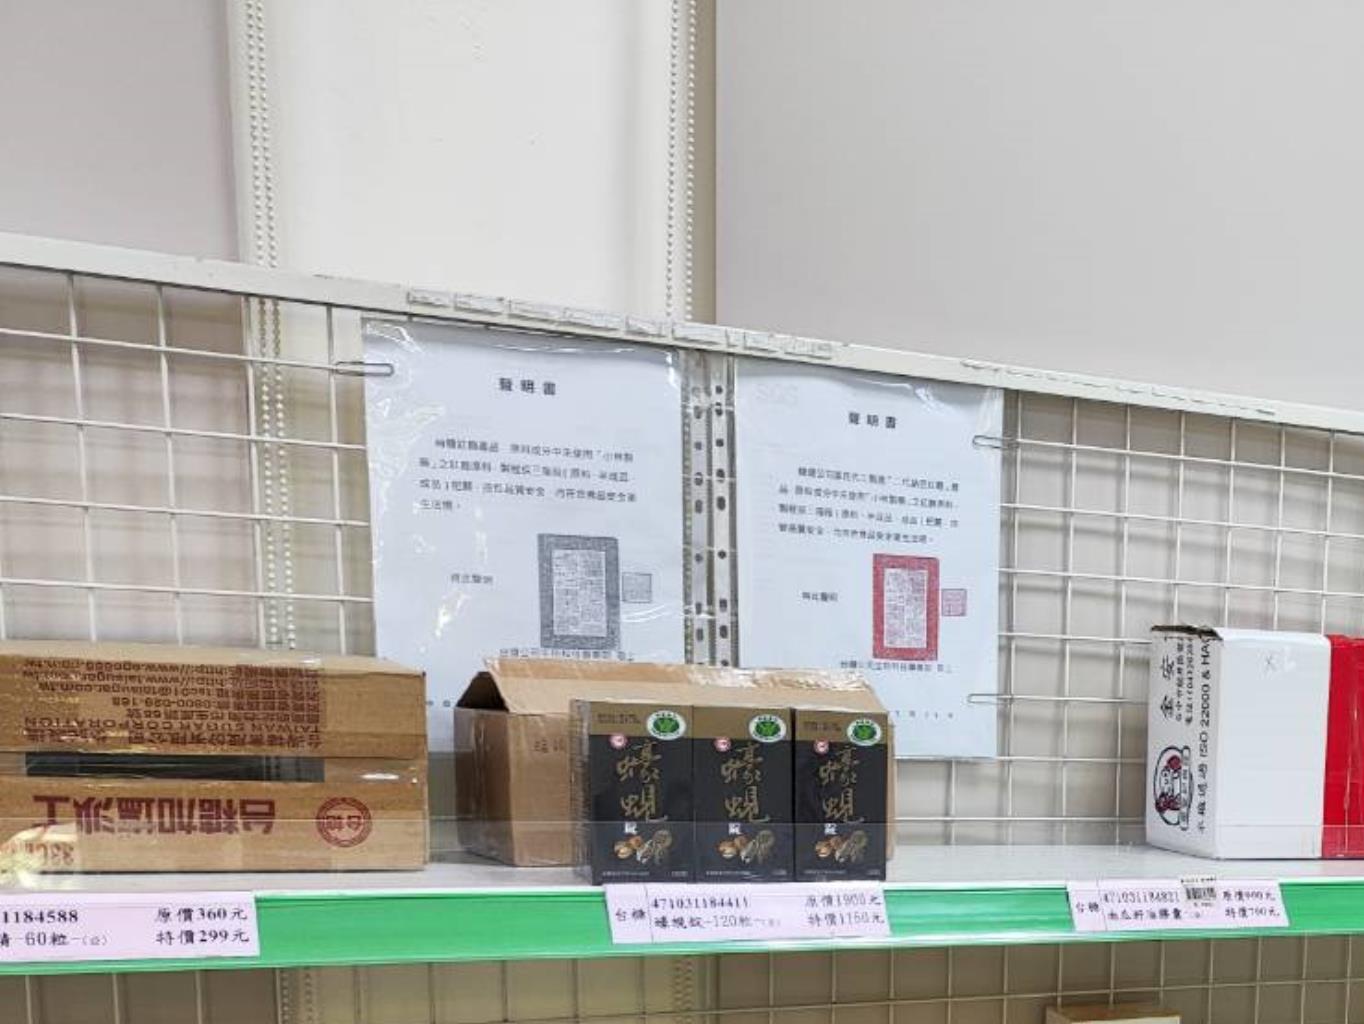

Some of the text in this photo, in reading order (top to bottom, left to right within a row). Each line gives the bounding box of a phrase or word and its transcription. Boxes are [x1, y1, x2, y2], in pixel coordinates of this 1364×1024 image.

[1199, 684, 1211, 728] 22000
[23, 717, 174, 730] CORPORATION
[1198, 731, 1209, 758] ISO
[154, 906, 249, 923] 原價360元
[156, 929, 250, 946] 特價299元
